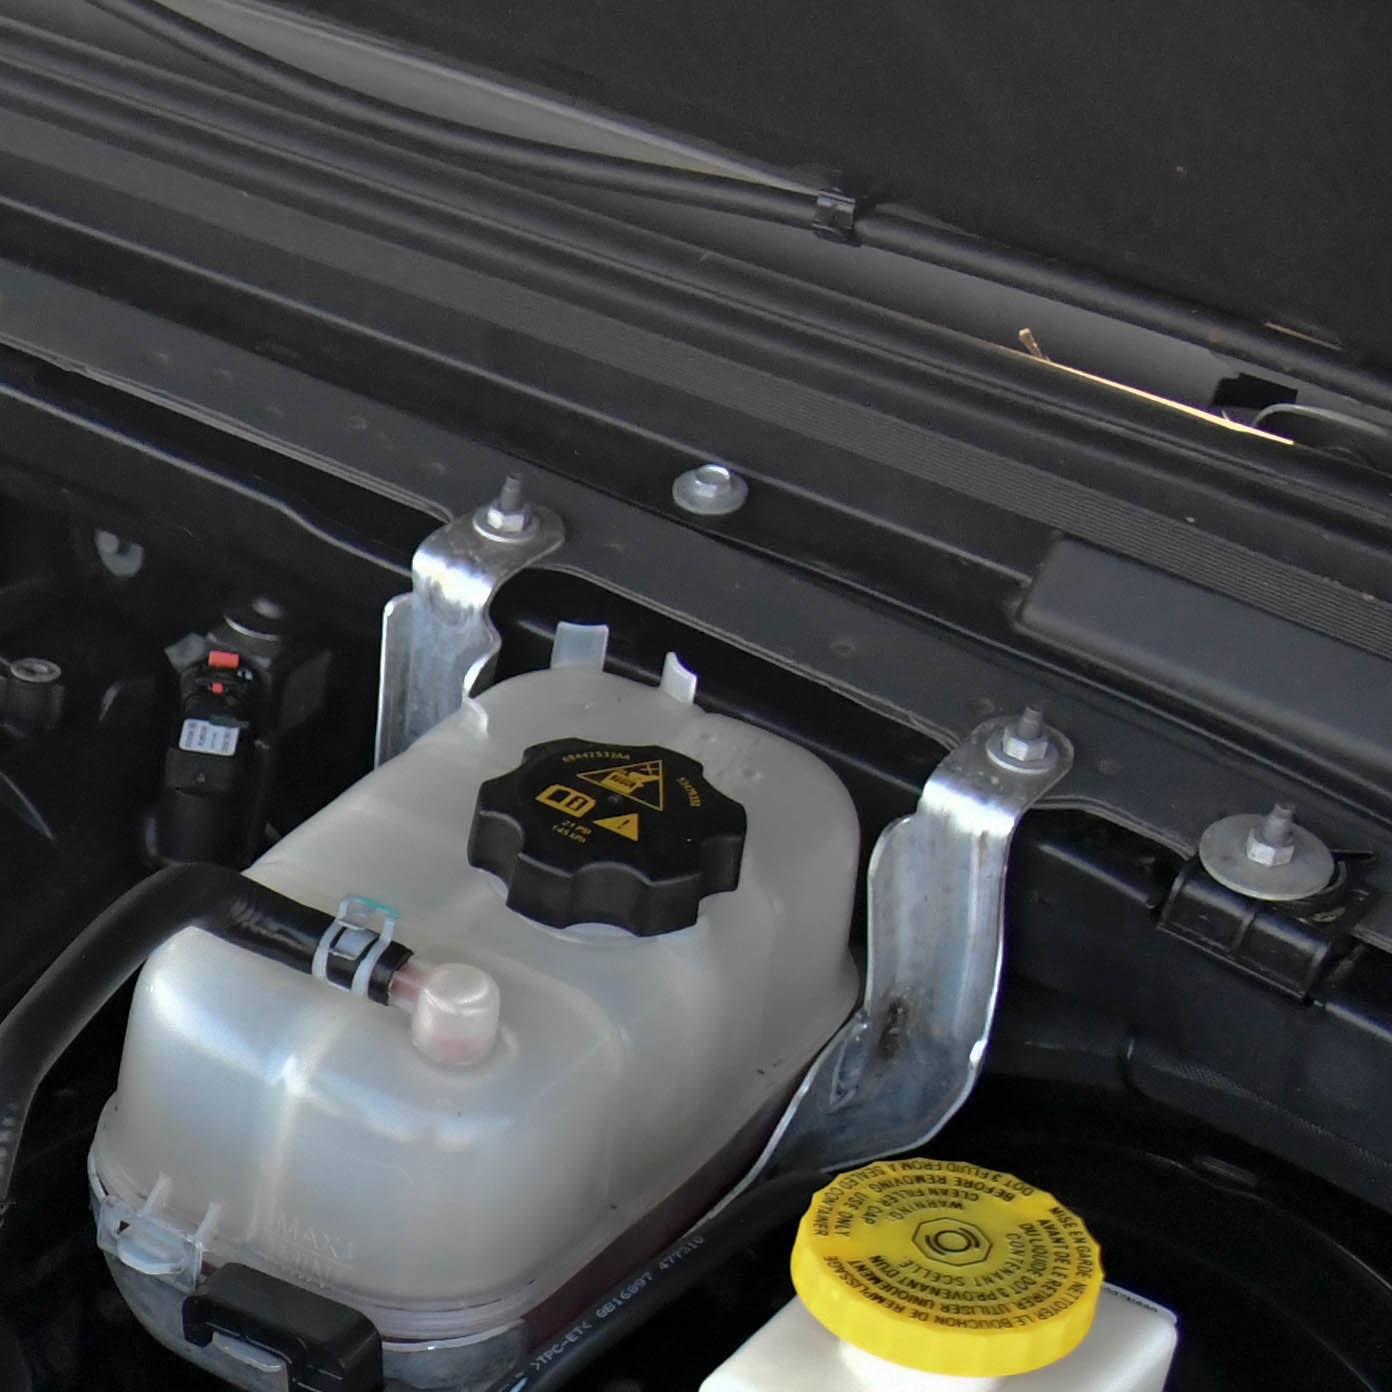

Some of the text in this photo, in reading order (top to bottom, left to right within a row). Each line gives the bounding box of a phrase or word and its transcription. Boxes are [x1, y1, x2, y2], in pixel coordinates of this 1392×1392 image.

[838, 1165, 887, 1191] SEALED
[899, 1161, 943, 1173] FROM
[944, 1162, 990, 1179] FLUID
[952, 1176, 1017, 1203] BEFORE
[1003, 1178, 1035, 1197] DOT
[812, 1186, 844, 1238] CONTAINER
[843, 1191, 869, 1212] USE
[860, 1187, 981, 1226] CLEAN FILLER CAP
[832, 1211, 854, 1239] ONLY
[1049, 1206, 1075, 1230] MISE
[1037, 1218, 1066, 1252] AVANT
[869, 1254, 902, 1281] D'UN
[974, 1231, 1021, 1288] CONTENANT
[1024, 1237, 1050, 1280] LIQUIDE
[823, 1255, 910, 1315] REMPLISSAGE
[847, 1258, 938, 1312] UNIQUEMENT
[904, 1275, 999, 1303] PROVENANT
[1009, 1273, 1039, 1297] DOT
[940, 1301, 1012, 1316] UTILISER
[1039, 1281, 1089, 1321] NETTOYER
[909, 1309, 930, 1323] DE
[933, 1315, 1014, 1330] BOUCHON
[1015, 1314, 1034, 1328] LE
